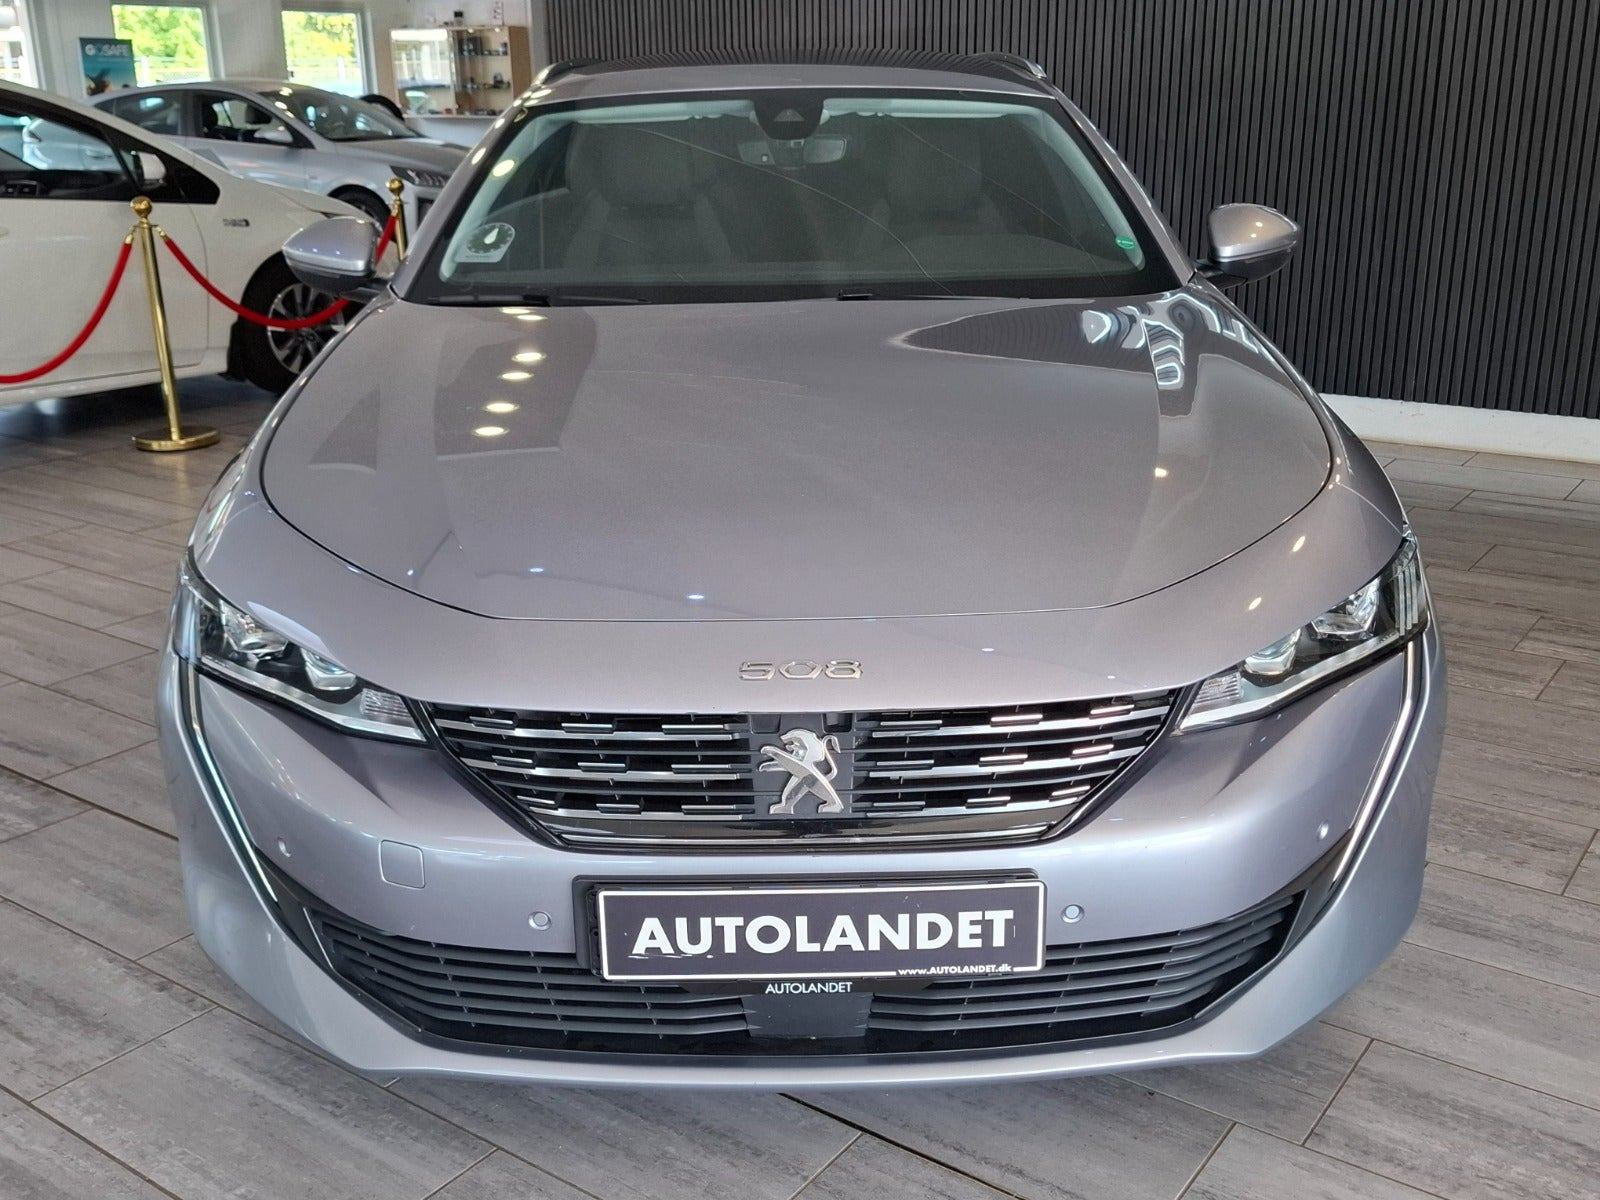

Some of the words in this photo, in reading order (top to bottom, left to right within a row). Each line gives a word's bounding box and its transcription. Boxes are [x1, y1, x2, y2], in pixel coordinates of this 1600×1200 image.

[739, 660, 863, 681] 508
[631, 909, 1014, 955] AUTOLANDET
[898, 964, 1012, 976] www.AUTOLANDET.dk
[765, 981, 853, 995] AUTOLANDET
